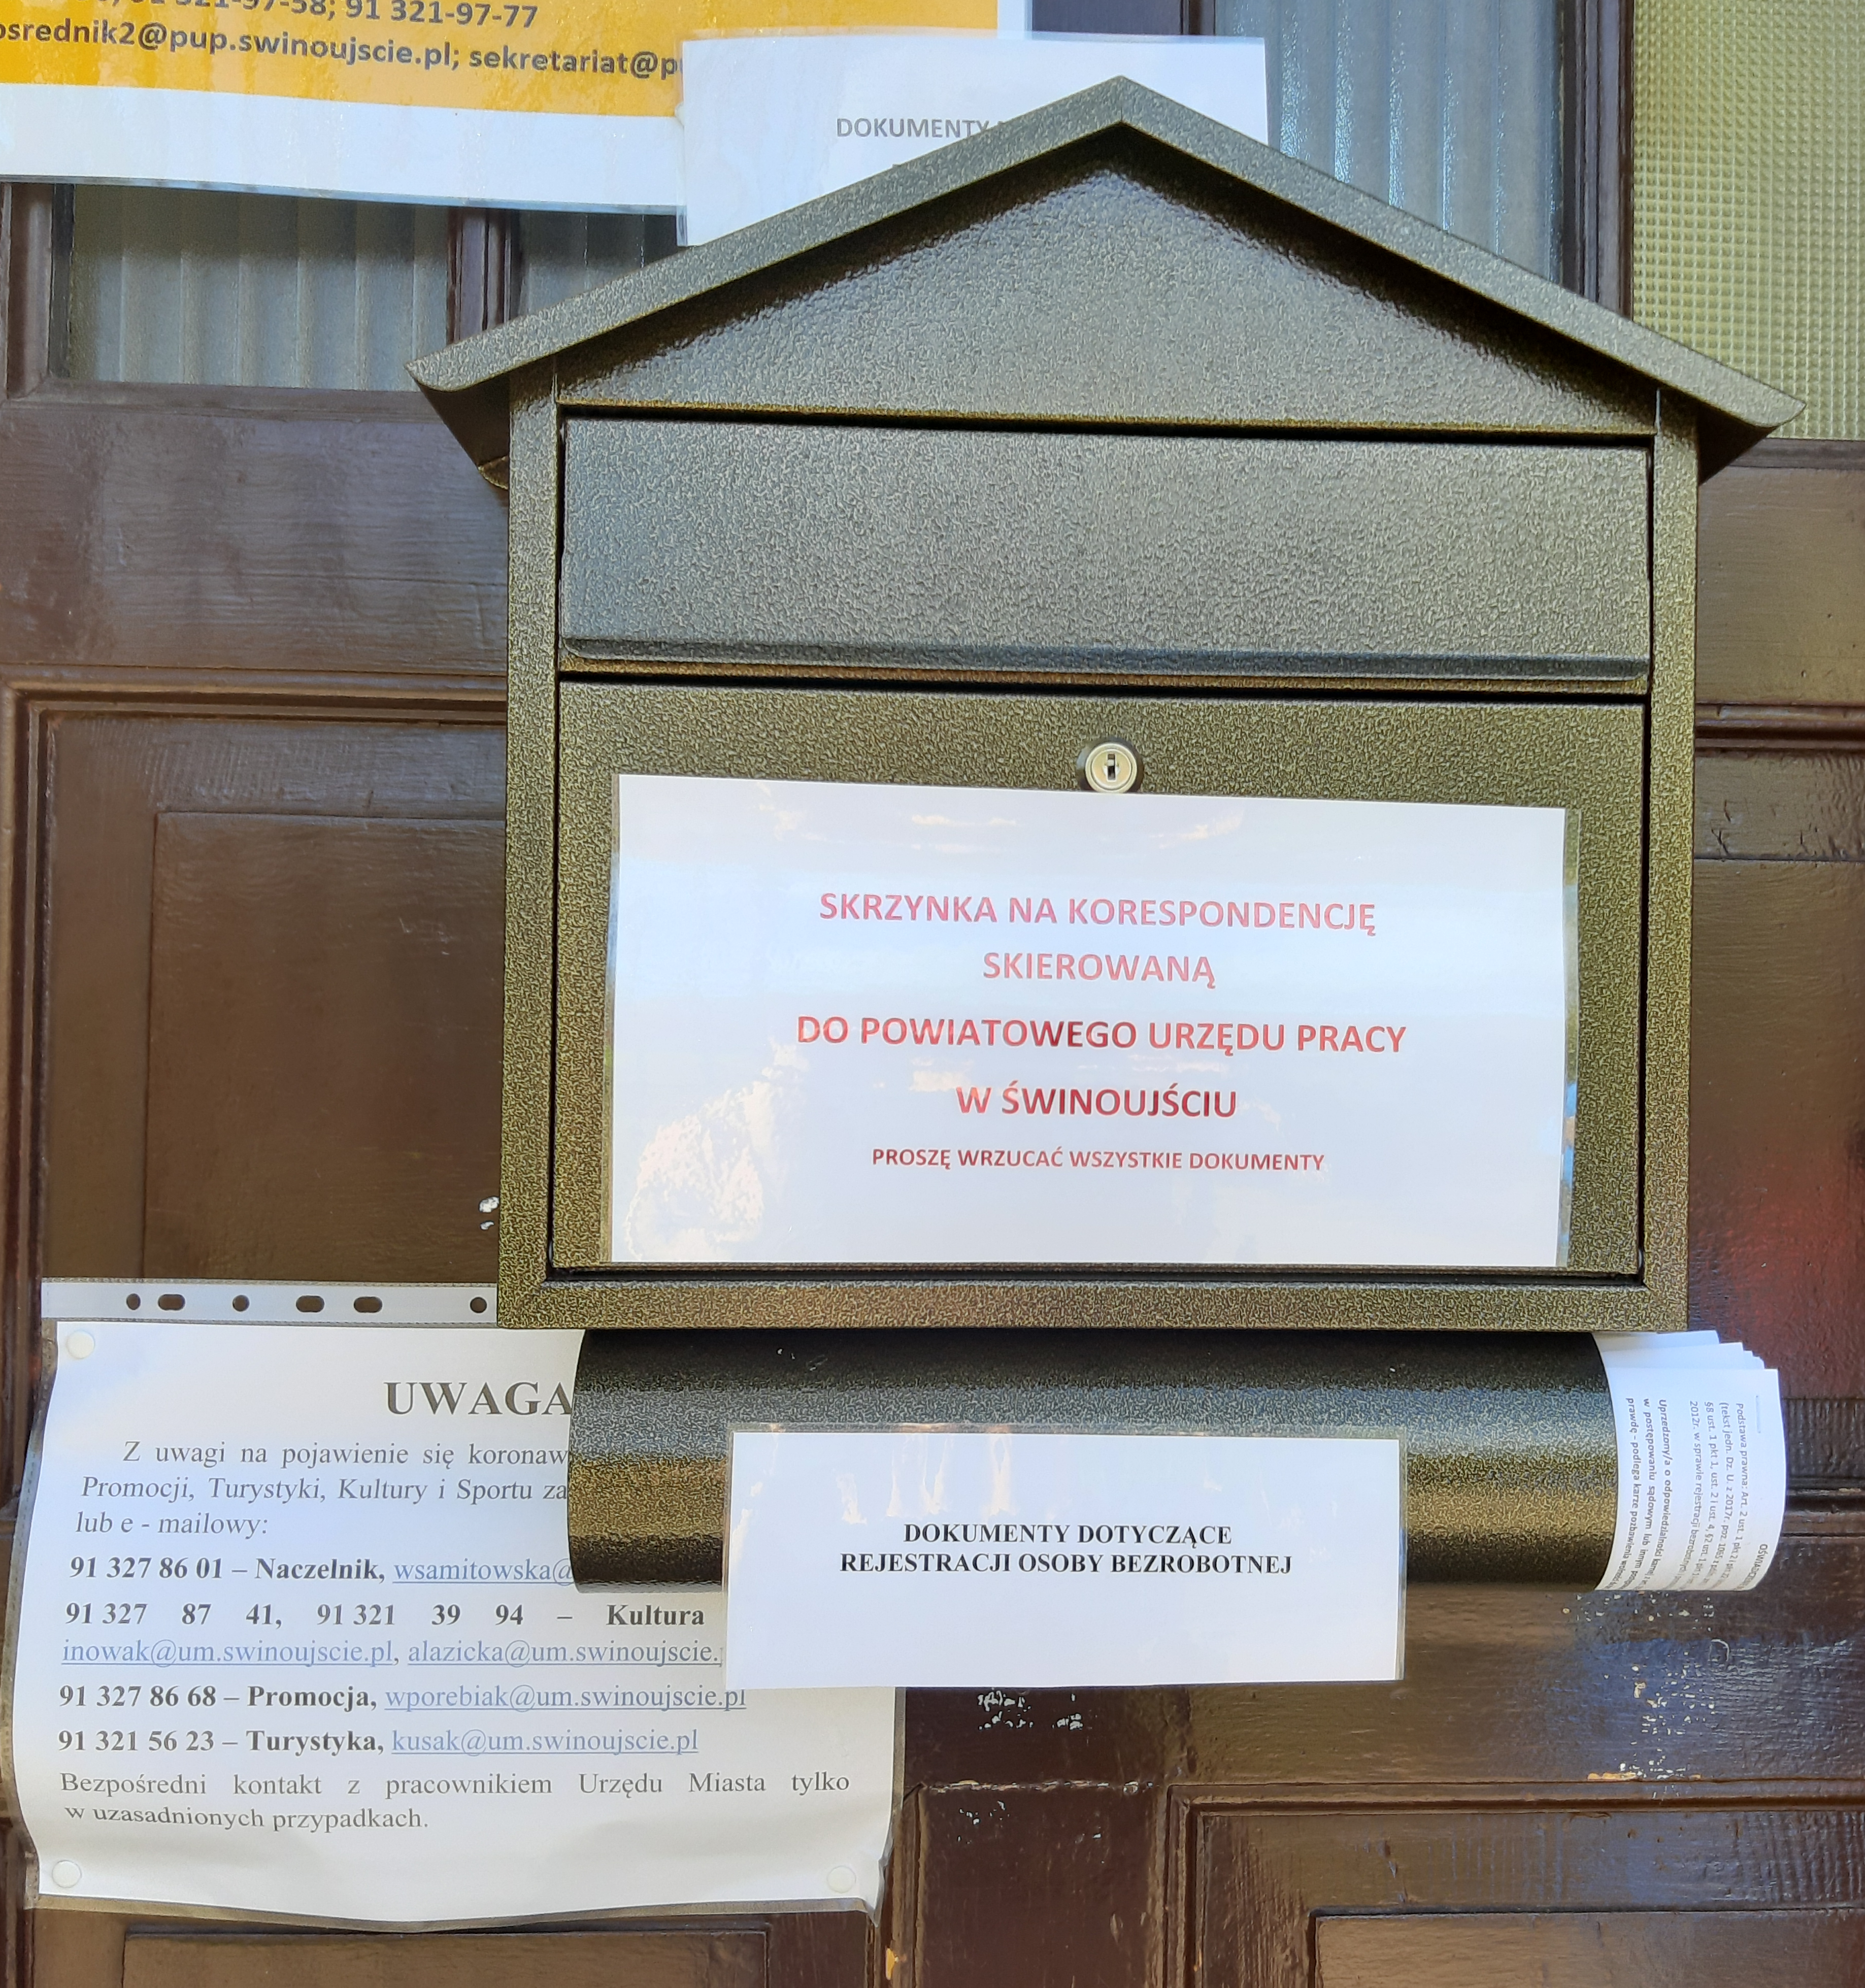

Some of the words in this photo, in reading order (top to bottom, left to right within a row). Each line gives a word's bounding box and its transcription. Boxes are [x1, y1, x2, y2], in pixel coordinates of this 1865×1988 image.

[345, 0, 380, 21] 91
[390, 0, 538, 28] 321-97-77
[468, 46, 683, 80] sekretariat@p
[836, 118, 989, 138] DOKUMENTY
[820, 893, 997, 922] SKRZYNKA
[1009, 898, 1057, 923] NA
[1069, 899, 1376, 937] KORESPONDENCJĘ
[983, 952, 1216, 989] SKIEROWANĄ
[798, 1016, 849, 1044] DO
[861, 1017, 1137, 1048] POWIATOWEGO
[1149, 1022, 1284, 1057] URZĘDU
[1297, 1024, 1407, 1053] PRACY
[956, 1087, 992, 1114] W
[1002, 1080, 1236, 1118] ŚWINOUJŚCIU
[873, 1148, 951, 1170] PROSZĘ
[957, 1146, 1063, 1167] WRZUCAĆ
[1069, 1151, 1182, 1169] WSZYSTKIE
[1189, 1152, 1324, 1171] DOKUMENTY
[385, 1381, 573, 1415] UWAGA
[1643, 1398, 1650, 1407] w
[1704, 1401, 1715, 1413] §8
[1625, 1397, 1640, 1434] prawdę
[1689, 1400, 1701, 1430] 2012r.
[1707, 1414, 1716, 1432] ust.
[1718, 1402, 1731, 1428] (tekst
[1736, 1403, 1747, 1448] Podstawa
[1643, 1411, 1657, 1481] postępowaniu
[1657, 1399, 1673, 1466] Uprzedzony/a
[1693, 1432, 1700, 1441] w
[1722, 1430, 1734, 1454] jedn.
[122, 1441, 141, 1462] Z
[155, 1441, 225, 1468] uwagi
[240, 1448, 267, 1463] na
[280, 1442, 409, 1469] pojawienie
[423, 1443, 454, 1470] się
[467, 1441, 568, 1467] koronaw
[1630, 1442, 1642, 1481] podlega
[1693, 1443, 1704, 1481] sprawie
[1708, 1443, 1719, 1458] pkt
[1726, 1456, 1734, 1471] Dz.
[1709, 1461, 1719, 1470] 1,
[1726, 1474, 1735, 1484] U.
[1739, 1450, 1748, 1488] prawna:
[81, 1476, 194, 1503] Promocji,
[208, 1477, 325, 1504] Turystyki,
[338, 1478, 428, 1505] Kultury
[439, 1478, 445, 1499] i
[457, 1479, 532, 1505] Sportu
[543, 1481, 567, 1501] za
[1710, 1472, 1719, 1489] ust.
[1632, 1483, 1642, 1509] karze
[1644, 1485, 1657, 1530] sądowym
[1690, 1482, 1704, 1528] rejestracji
[1723, 1494, 1735, 1522] 2017r.
[1740, 1491, 1749, 1508] Art.
[75, 1511, 113, 1533] lub
[121, 1518, 134, 1533] e
[157, 1512, 268, 1540] mailowy:
[1654, 1479, 1673, 1556] odpowiedzialności
[1705, 1523, 1716, 1532] 4,
[1708, 1506, 1717, 1522] ust.
[1736, 1519, 1746, 1534] ust.
[903, 1523, 1071, 1543] DOKUMENTY
[1077, 1525, 1232, 1549] DOTYCZĄCE
[1623, 1511, 1638, 1559] pozbawienia
[1642, 1533, 1652, 1546] lub
[1720, 1525, 1730, 1541] poz.
[70, 1556, 96, 1578] 91
[106, 1556, 152, 1578] 327
[159, 1557, 188, 1578] 86
[196, 1558, 222, 1579] 01
[254, 1558, 385, 1584] Naczelnik,
[392, 1557, 574, 1586] wsamitowska@
[839, 1553, 1011, 1572] REJESTRACJI
[1018, 1553, 1104, 1573] OSOBY
[1110, 1554, 1292, 1574] BEZROBOTNEJ
[1635, 1549, 1649, 1569] innym
[65, 1602, 92, 1624] 91
[102, 1603, 148, 1625] 327
[182, 1603, 212, 1625] 87
[246, 1604, 282, 1629] 41,
[317, 1604, 343, 1625] 91
[353, 1604, 394, 1625] 321
[431, 1604, 460, 1626] 39
[495, 1604, 523, 1626] 94
[606, 1604, 705, 1626] Kultura
[61, 1639, 399, 1668] inowak@um.swinoujscie.pl,
[407, 1639, 722, 1668] alazicka@um.swinoujscie.
[59, 1685, 86, 1707] 91
[96, 1685, 142, 1707] 327
[150, 1685, 179, 1707] 86
[187, 1685, 216, 1707] 68
[247, 1685, 377, 1712] Promocja,
[384, 1684, 747, 1711] wporebiak@um.swinoujscie.pl
[58, 1730, 86, 1751] 91
[95, 1730, 138, 1751] 321
[148, 1730, 177, 1751] 56
[186, 1730, 214, 1751] 23
[246, 1730, 384, 1757] Turystyka,
[391, 1729, 698, 1757] kusak@um.swinoujscie.pl
[59, 1773, 206, 1798] Bezpośredni
[234, 1774, 322, 1795] kontakt
[347, 1780, 360, 1794] z
[385, 1773, 552, 1800] pracownikiem
[579, 1772, 662, 1799] Urzędu
[688, 1772, 766, 1793] Miasta
[791, 1771, 849, 1796] tylko
[64, 1807, 85, 1819] w
[92, 1806, 264, 1830] uzasadnionych
[273, 1808, 428, 1833] przypadkach.
